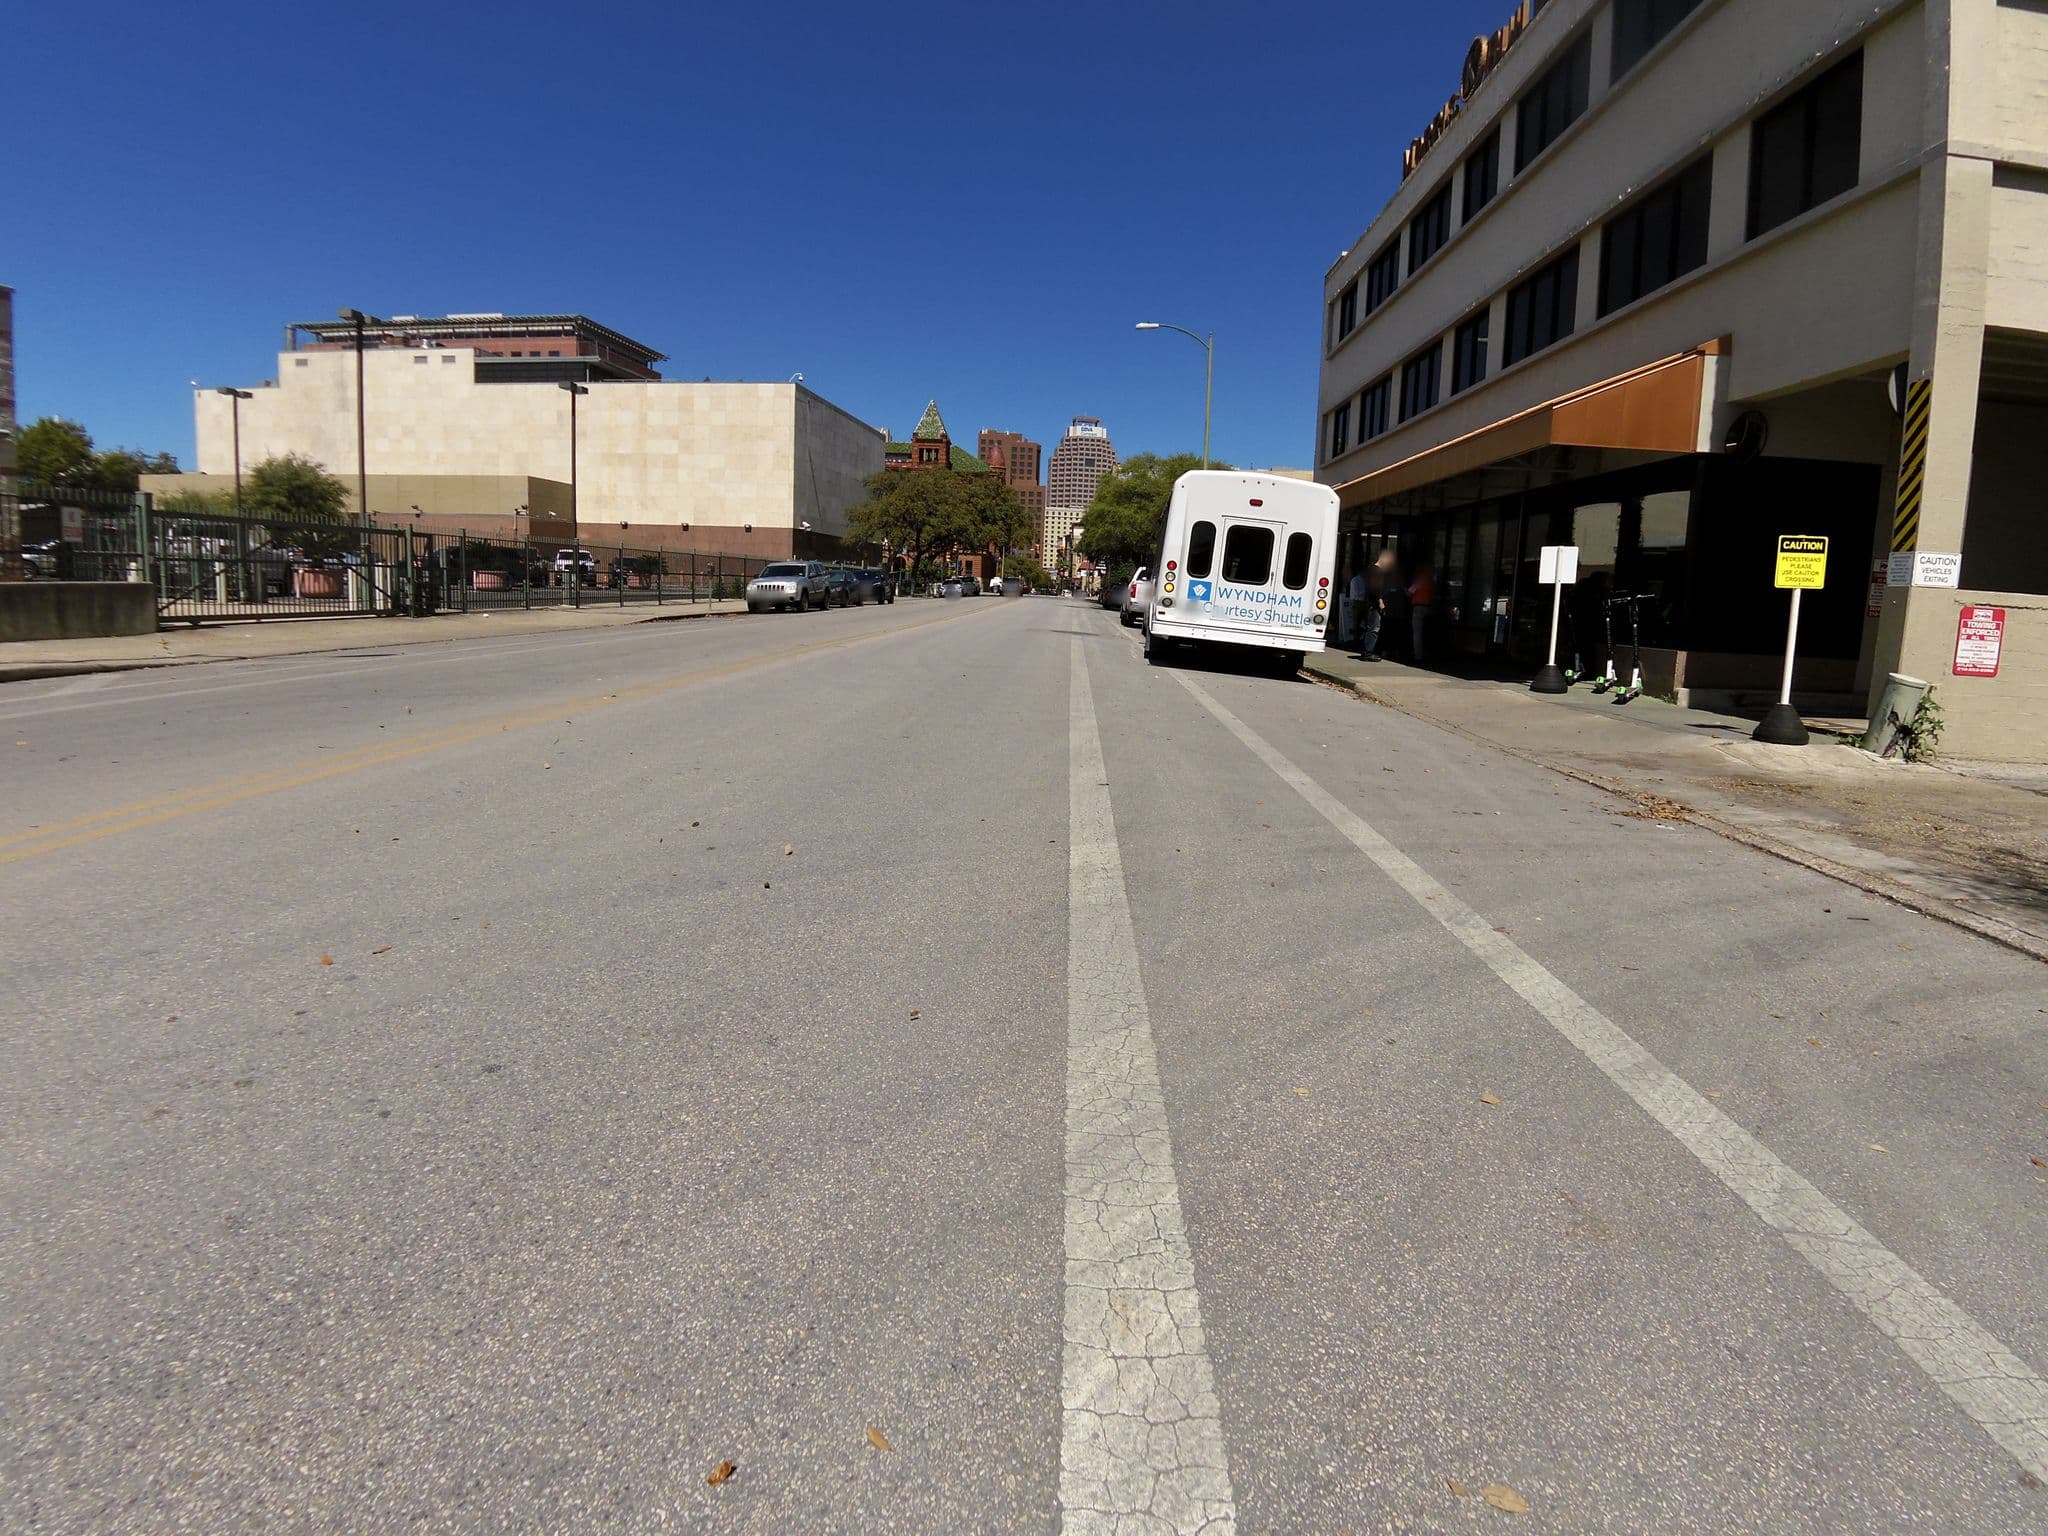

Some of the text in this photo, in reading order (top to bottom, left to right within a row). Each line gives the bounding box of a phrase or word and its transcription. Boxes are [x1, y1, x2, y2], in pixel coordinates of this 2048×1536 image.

[1783, 541, 1823, 550] CAUTION
[1919, 556, 1957, 566] CAUTION
[1921, 567, 1952, 575] VEHICLES
[1923, 575, 1949, 583] EXITING
[1218, 586, 1302, 607] WYNDHAM
[1263, 609, 1311, 625] Shuttle
[1967, 621, 1996, 629] TOWING
